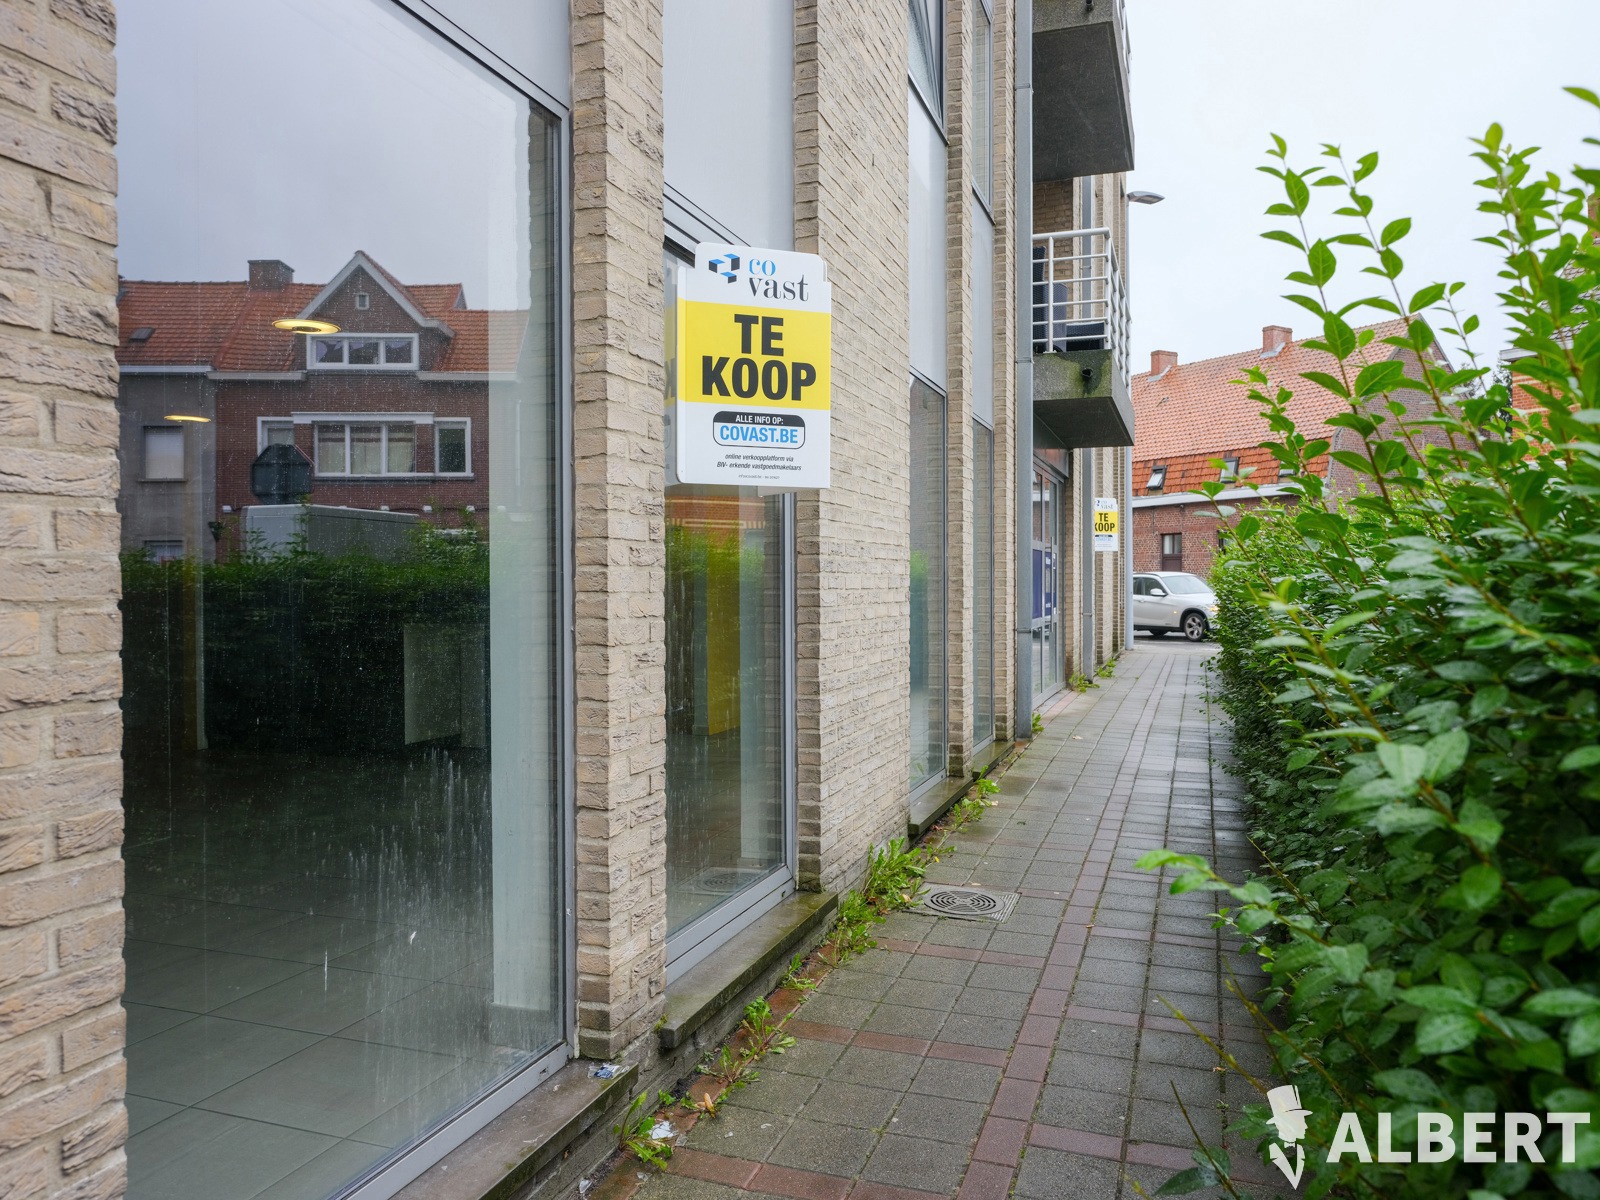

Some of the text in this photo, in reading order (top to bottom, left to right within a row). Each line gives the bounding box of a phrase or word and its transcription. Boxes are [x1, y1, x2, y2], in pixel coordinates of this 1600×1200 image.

[749, 258, 776, 277] co
[749, 274, 809, 302] vast
[734, 313, 784, 357] TE
[702, 355, 817, 402] KOOP
[735, 414, 784, 425] ALLE INFO OP:
[719, 425, 799, 444] COVAST.BE
[742, 454, 786, 463] verkoopplatform
[752, 463, 802, 471] vastgoedmakelaars
[1098, 512, 1109, 522] TE
